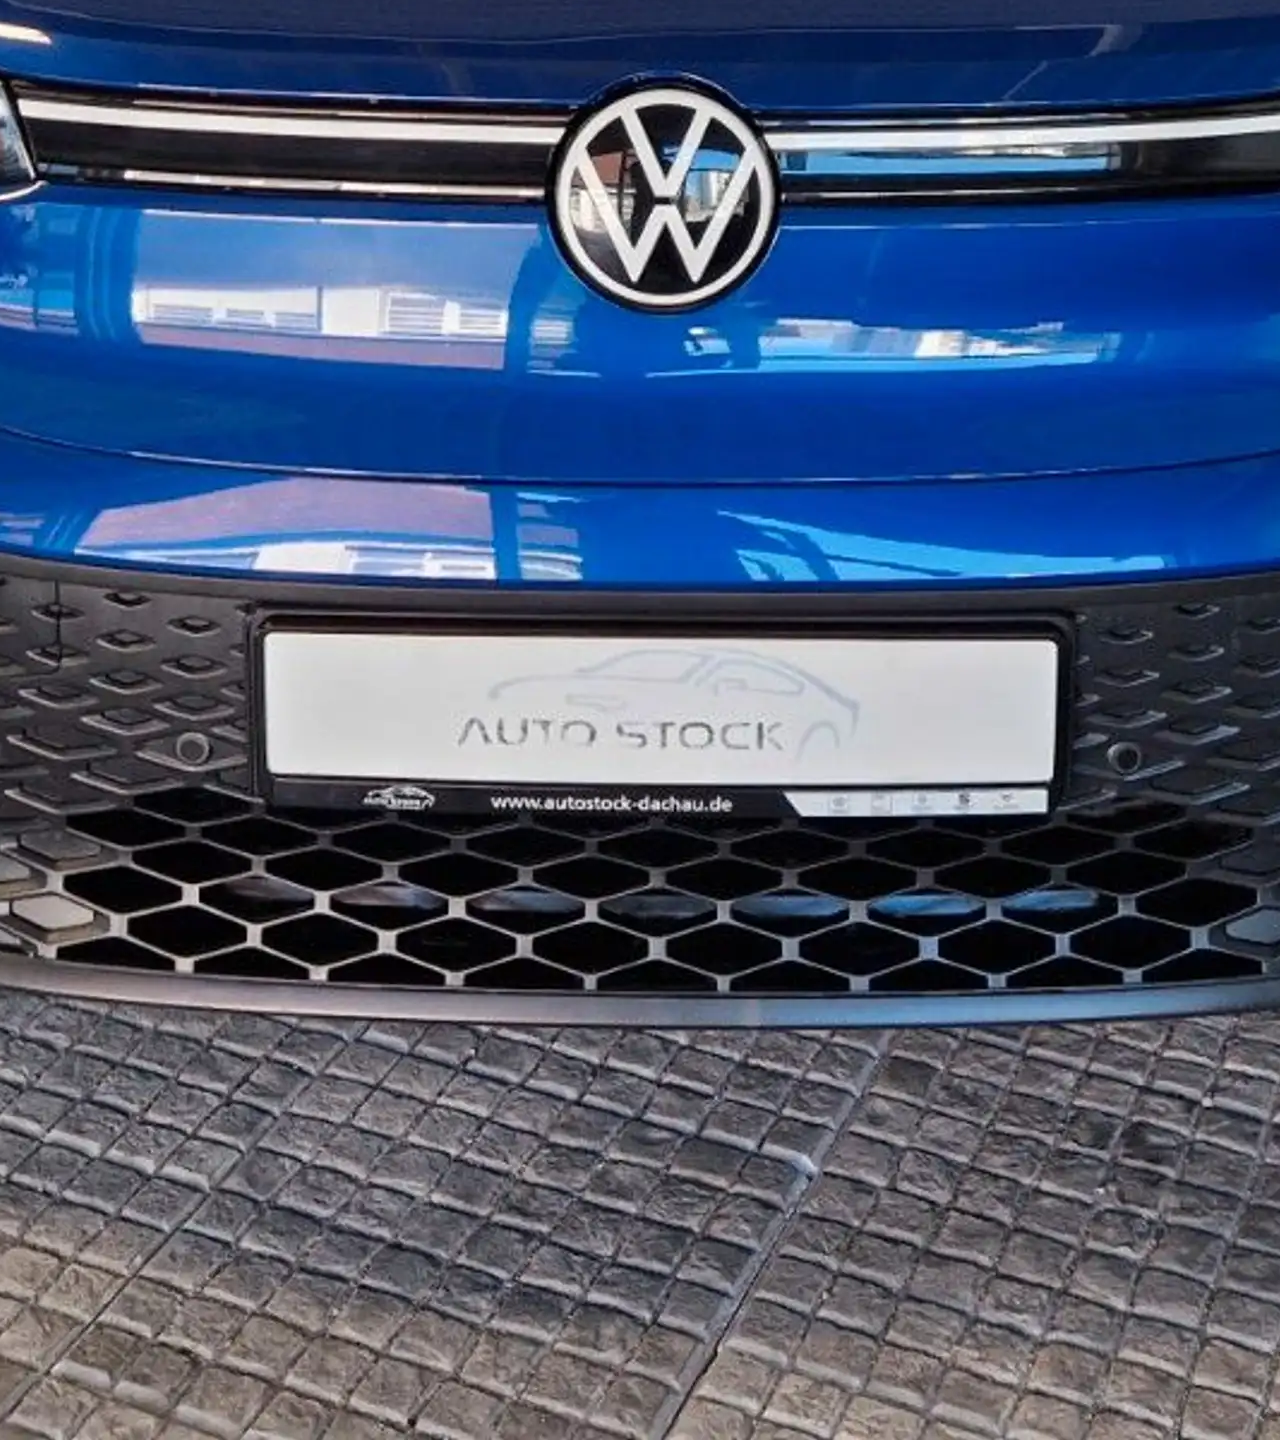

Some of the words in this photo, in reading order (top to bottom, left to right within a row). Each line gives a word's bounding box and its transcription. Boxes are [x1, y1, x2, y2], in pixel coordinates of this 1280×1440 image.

[457, 717, 598, 747] AUTO
[616, 721, 784, 751] STOCK
[490, 794, 733, 813] www.autostock-dachau.de
